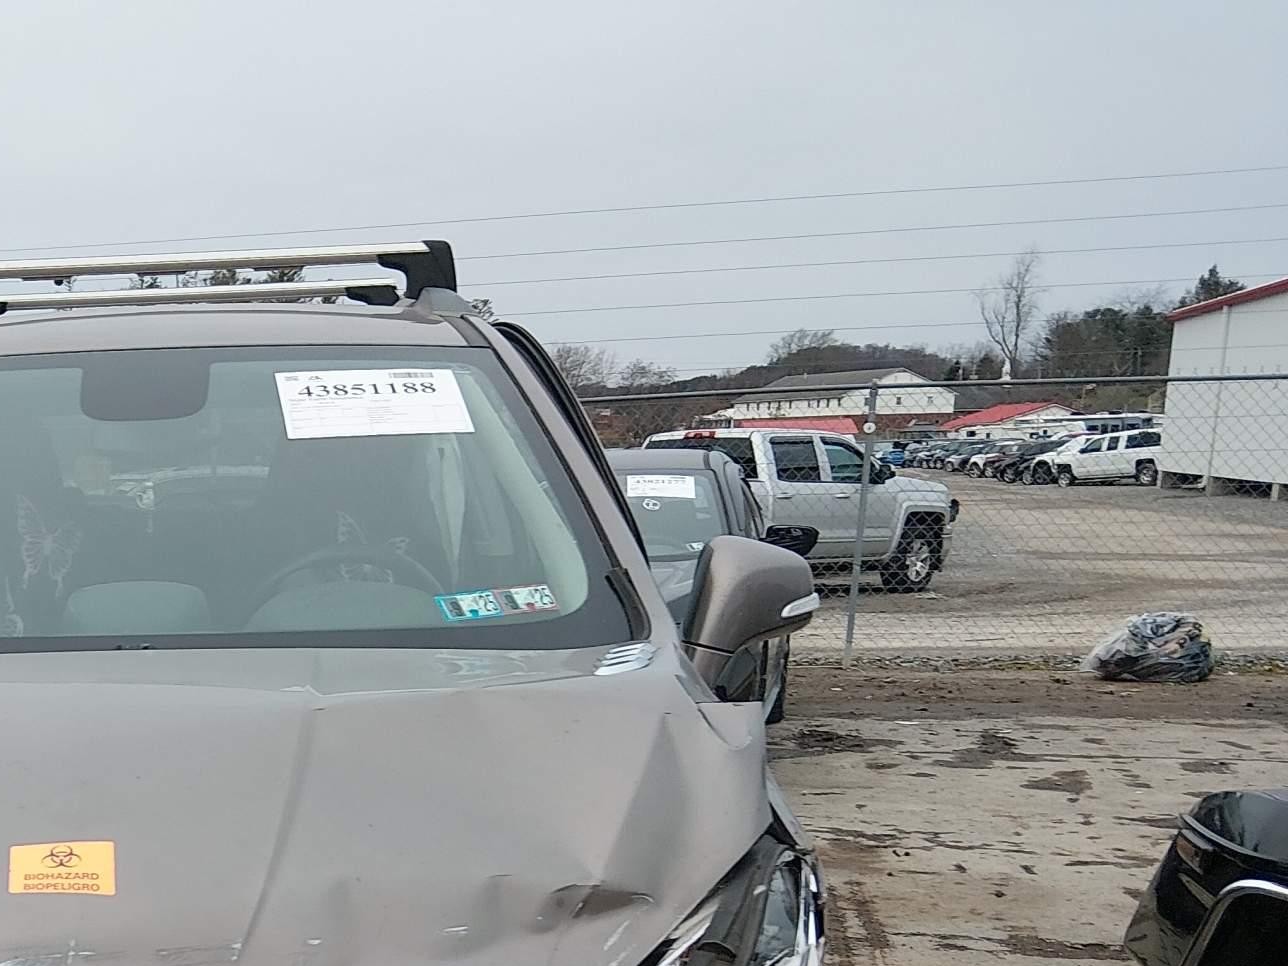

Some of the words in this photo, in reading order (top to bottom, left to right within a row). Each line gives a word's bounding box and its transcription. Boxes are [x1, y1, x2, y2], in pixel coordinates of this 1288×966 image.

[297, 381, 437, 398] 43851188
[23, 872, 100, 881] BIOHAZARD
[23, 882, 101, 892] BIOPELIGRO
